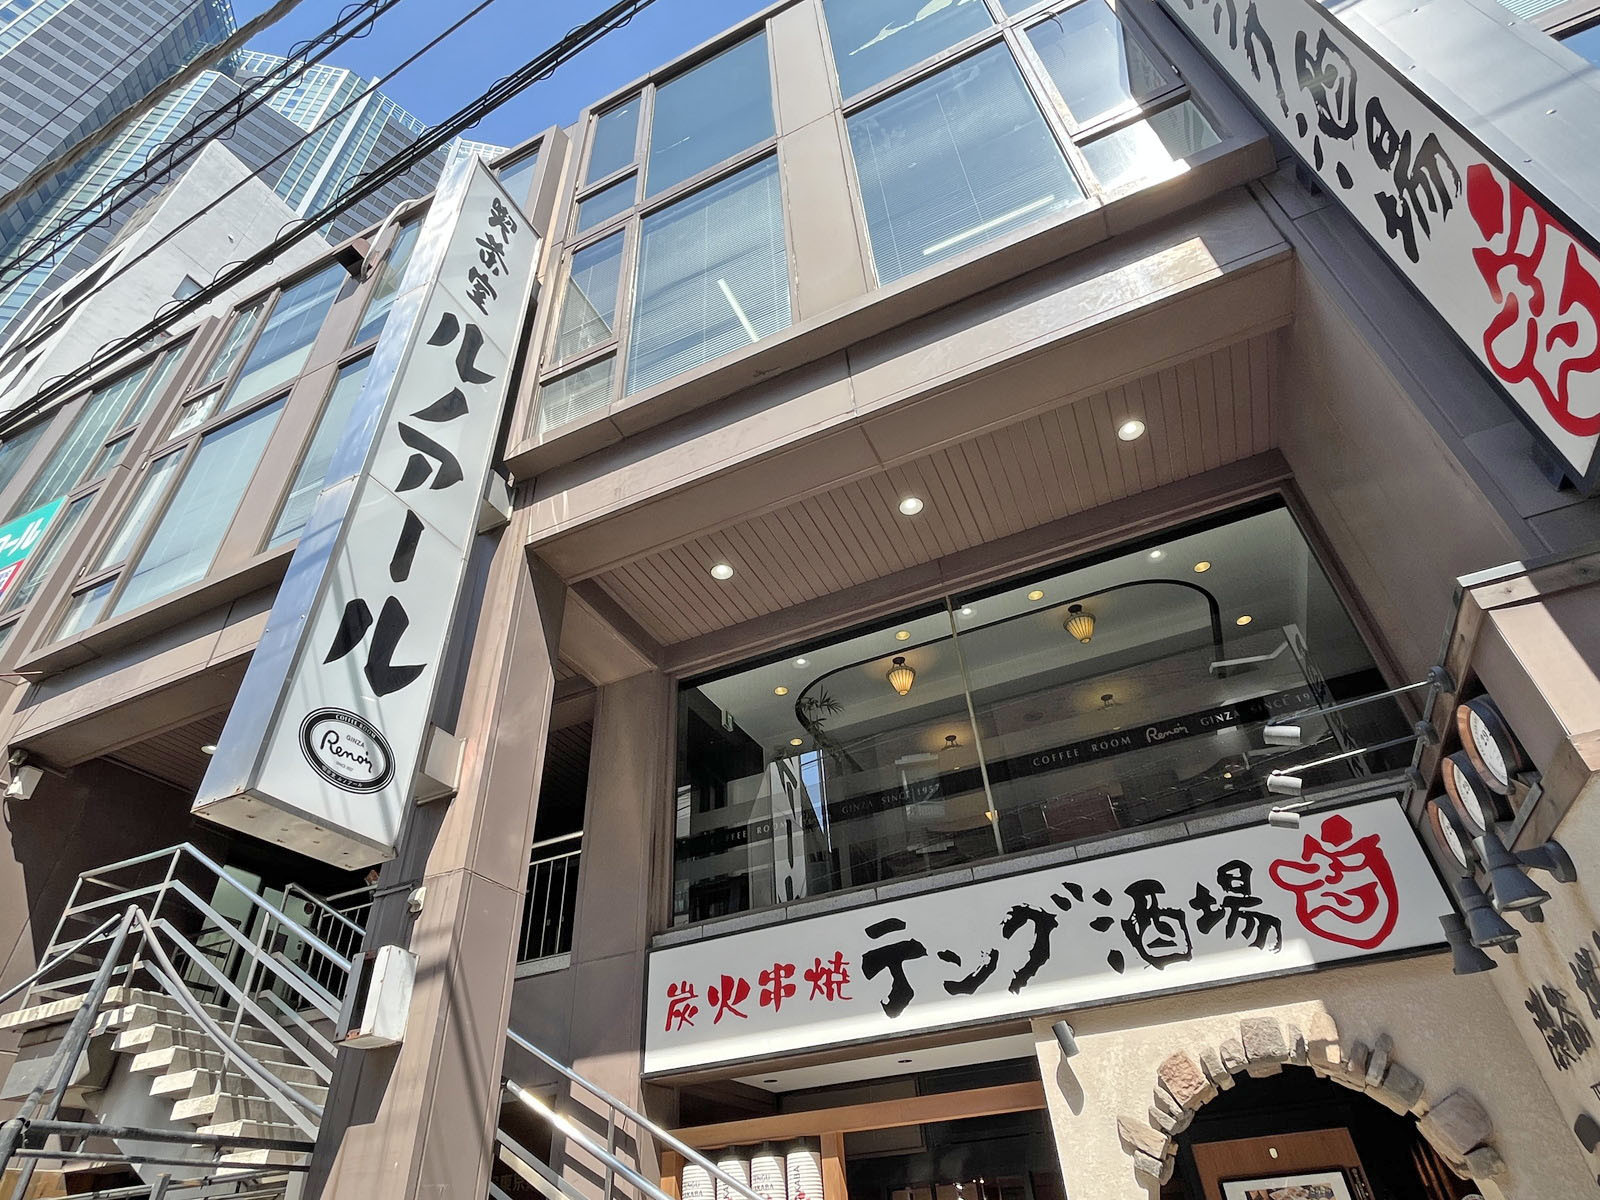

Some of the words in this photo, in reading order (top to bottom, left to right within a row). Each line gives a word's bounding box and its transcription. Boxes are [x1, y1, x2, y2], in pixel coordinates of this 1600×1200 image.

[466, 197, 518, 315] 喫茶室
[323, 312, 496, 697] ルノアール
[320, 729, 373, 774] Renoir
[346, 734, 365, 749] GINZA
[1032, 748, 1081, 767] COFFEE
[1091, 736, 1132, 753] ROOM
[1145, 722, 1190, 744] Renoir
[1200, 710, 1241, 727] GINZA
[665, 951, 854, 1031] 炭火串焼
[861, 858, 1283, 1019] テング酒場
